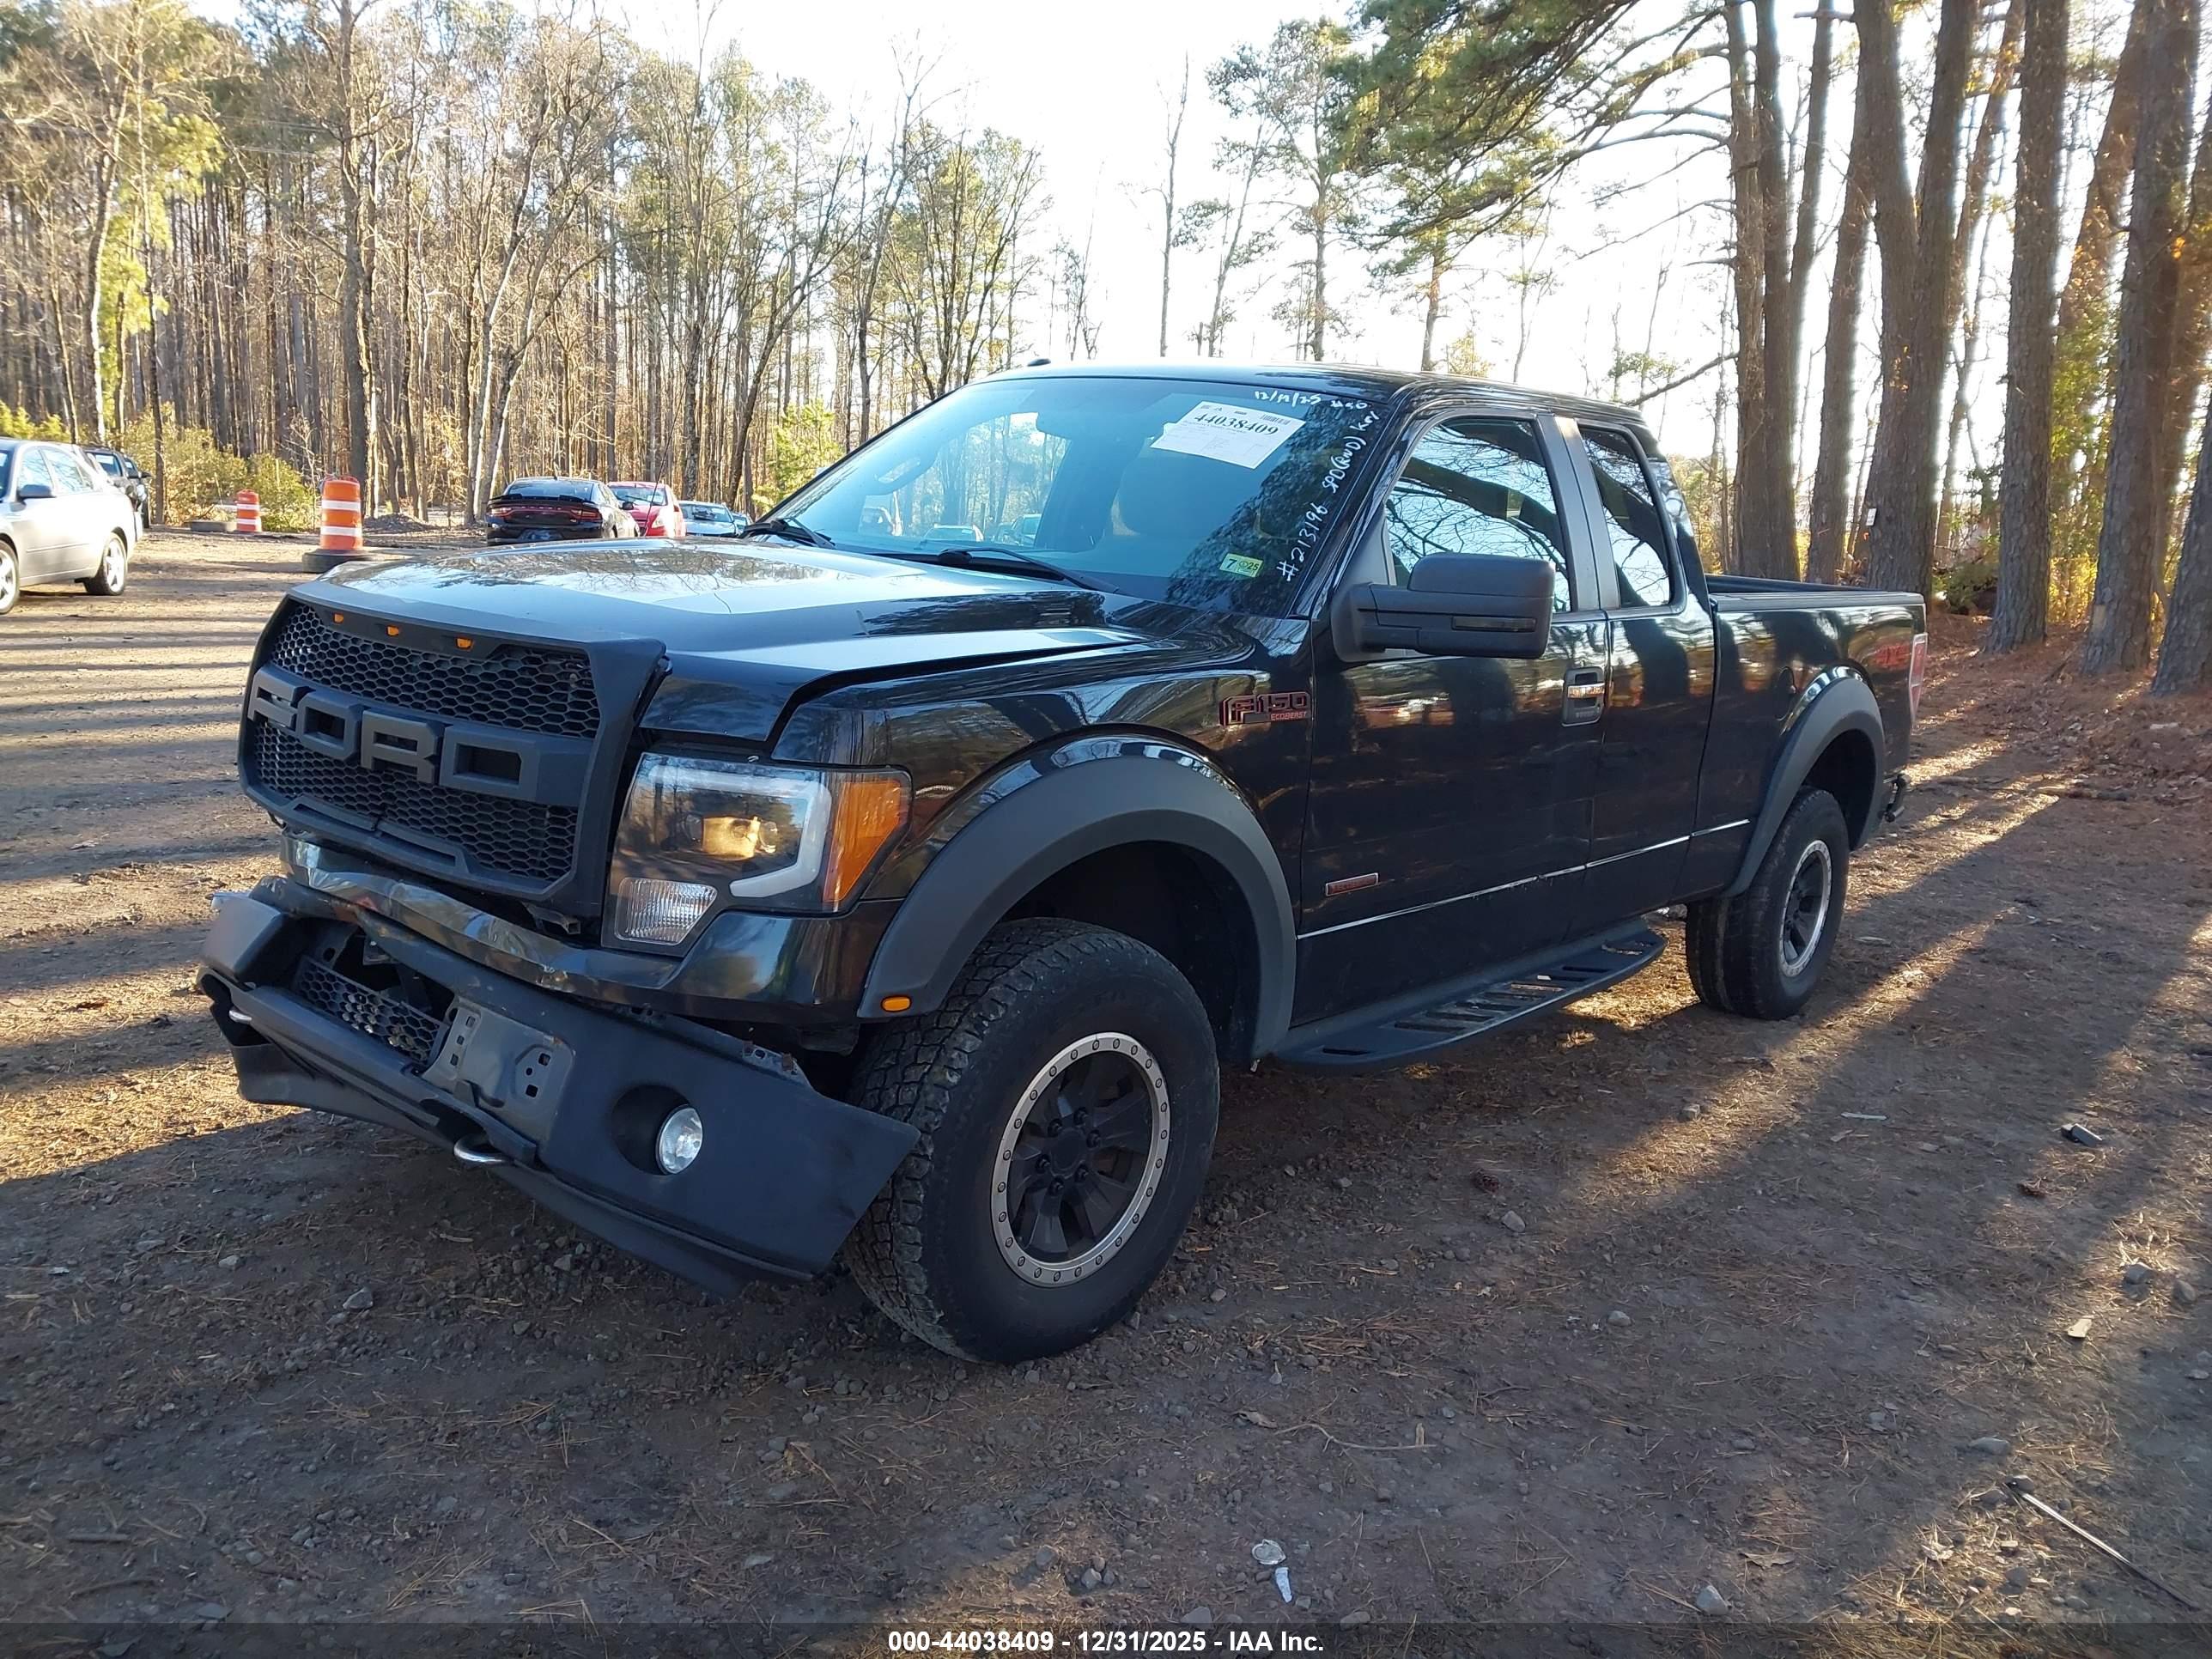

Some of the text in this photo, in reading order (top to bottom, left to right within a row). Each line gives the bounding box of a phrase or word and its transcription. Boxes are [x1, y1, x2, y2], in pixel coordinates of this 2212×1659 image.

[1194, 413, 1279, 435] 44038409
[1225, 558, 1260, 571] 7 25
[1276, 502, 1328, 581] #213196
[247, 665, 541, 802] FORD
